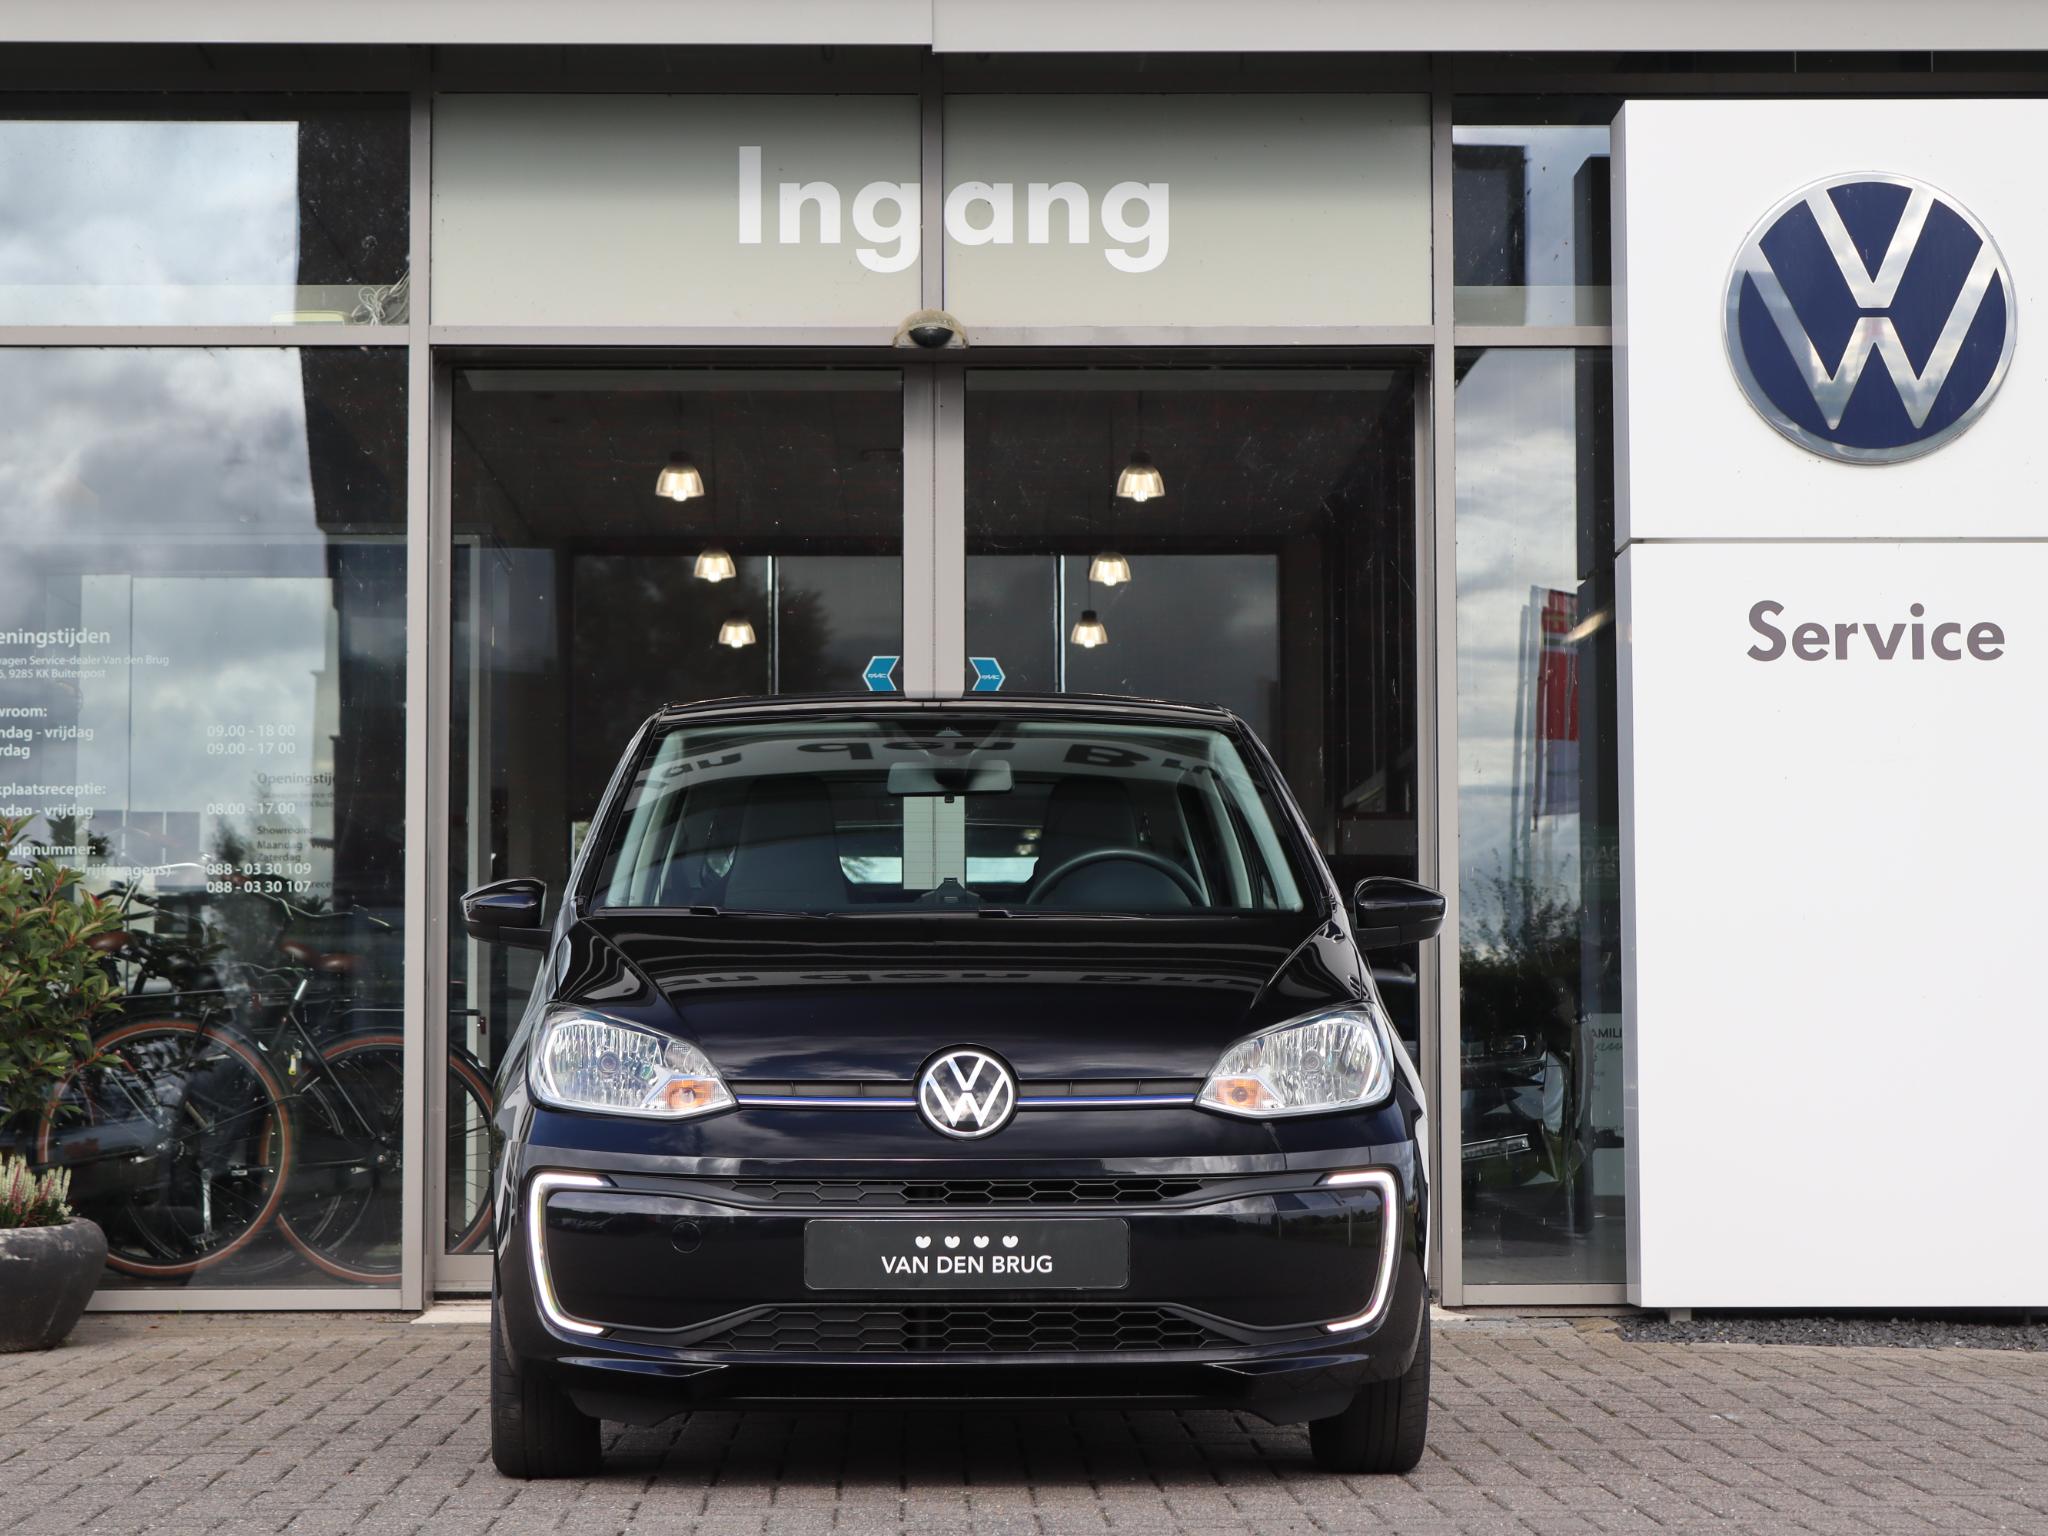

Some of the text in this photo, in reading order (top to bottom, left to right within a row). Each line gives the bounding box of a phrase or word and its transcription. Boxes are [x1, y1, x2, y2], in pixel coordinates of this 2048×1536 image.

[739, 146, 1169, 273] Ingang
[1747, 600, 2006, 662] Service
[0, 655, 170, 668] agen Service-dealer Van den Brug
[8, 669, 33, 679] 9285
[36, 669, 50, 679] KK
[51, 668, 107, 681] Buitenpost
[44, 725, 95, 742] vrijdag
[206, 724, 246, 737] 09.00
[257, 724, 297, 737] 1800
[206, 742, 246, 755] 09.00
[257, 742, 297, 755] 1700
[256, 771, 335, 787] Openingstij
[0, 781, 107, 799] plaatsreceptie:
[44, 803, 94, 820] vrijdag
[206, 802, 246, 816] 08.00
[257, 802, 297, 816] 17.00
[0, 843, 96, 859] ulpnummer:
[205, 863, 233, 875] 088
[244, 863, 261, 875] 03
[264, 863, 282, 875] 30
[286, 863, 312, 875] 109
[205, 880, 233, 893] 088
[244, 880, 261, 893] 03
[264, 880, 282, 893] 30
[286, 880, 312, 893] 107
[881, 1254, 1053, 1274] VAN DEN BRUG
